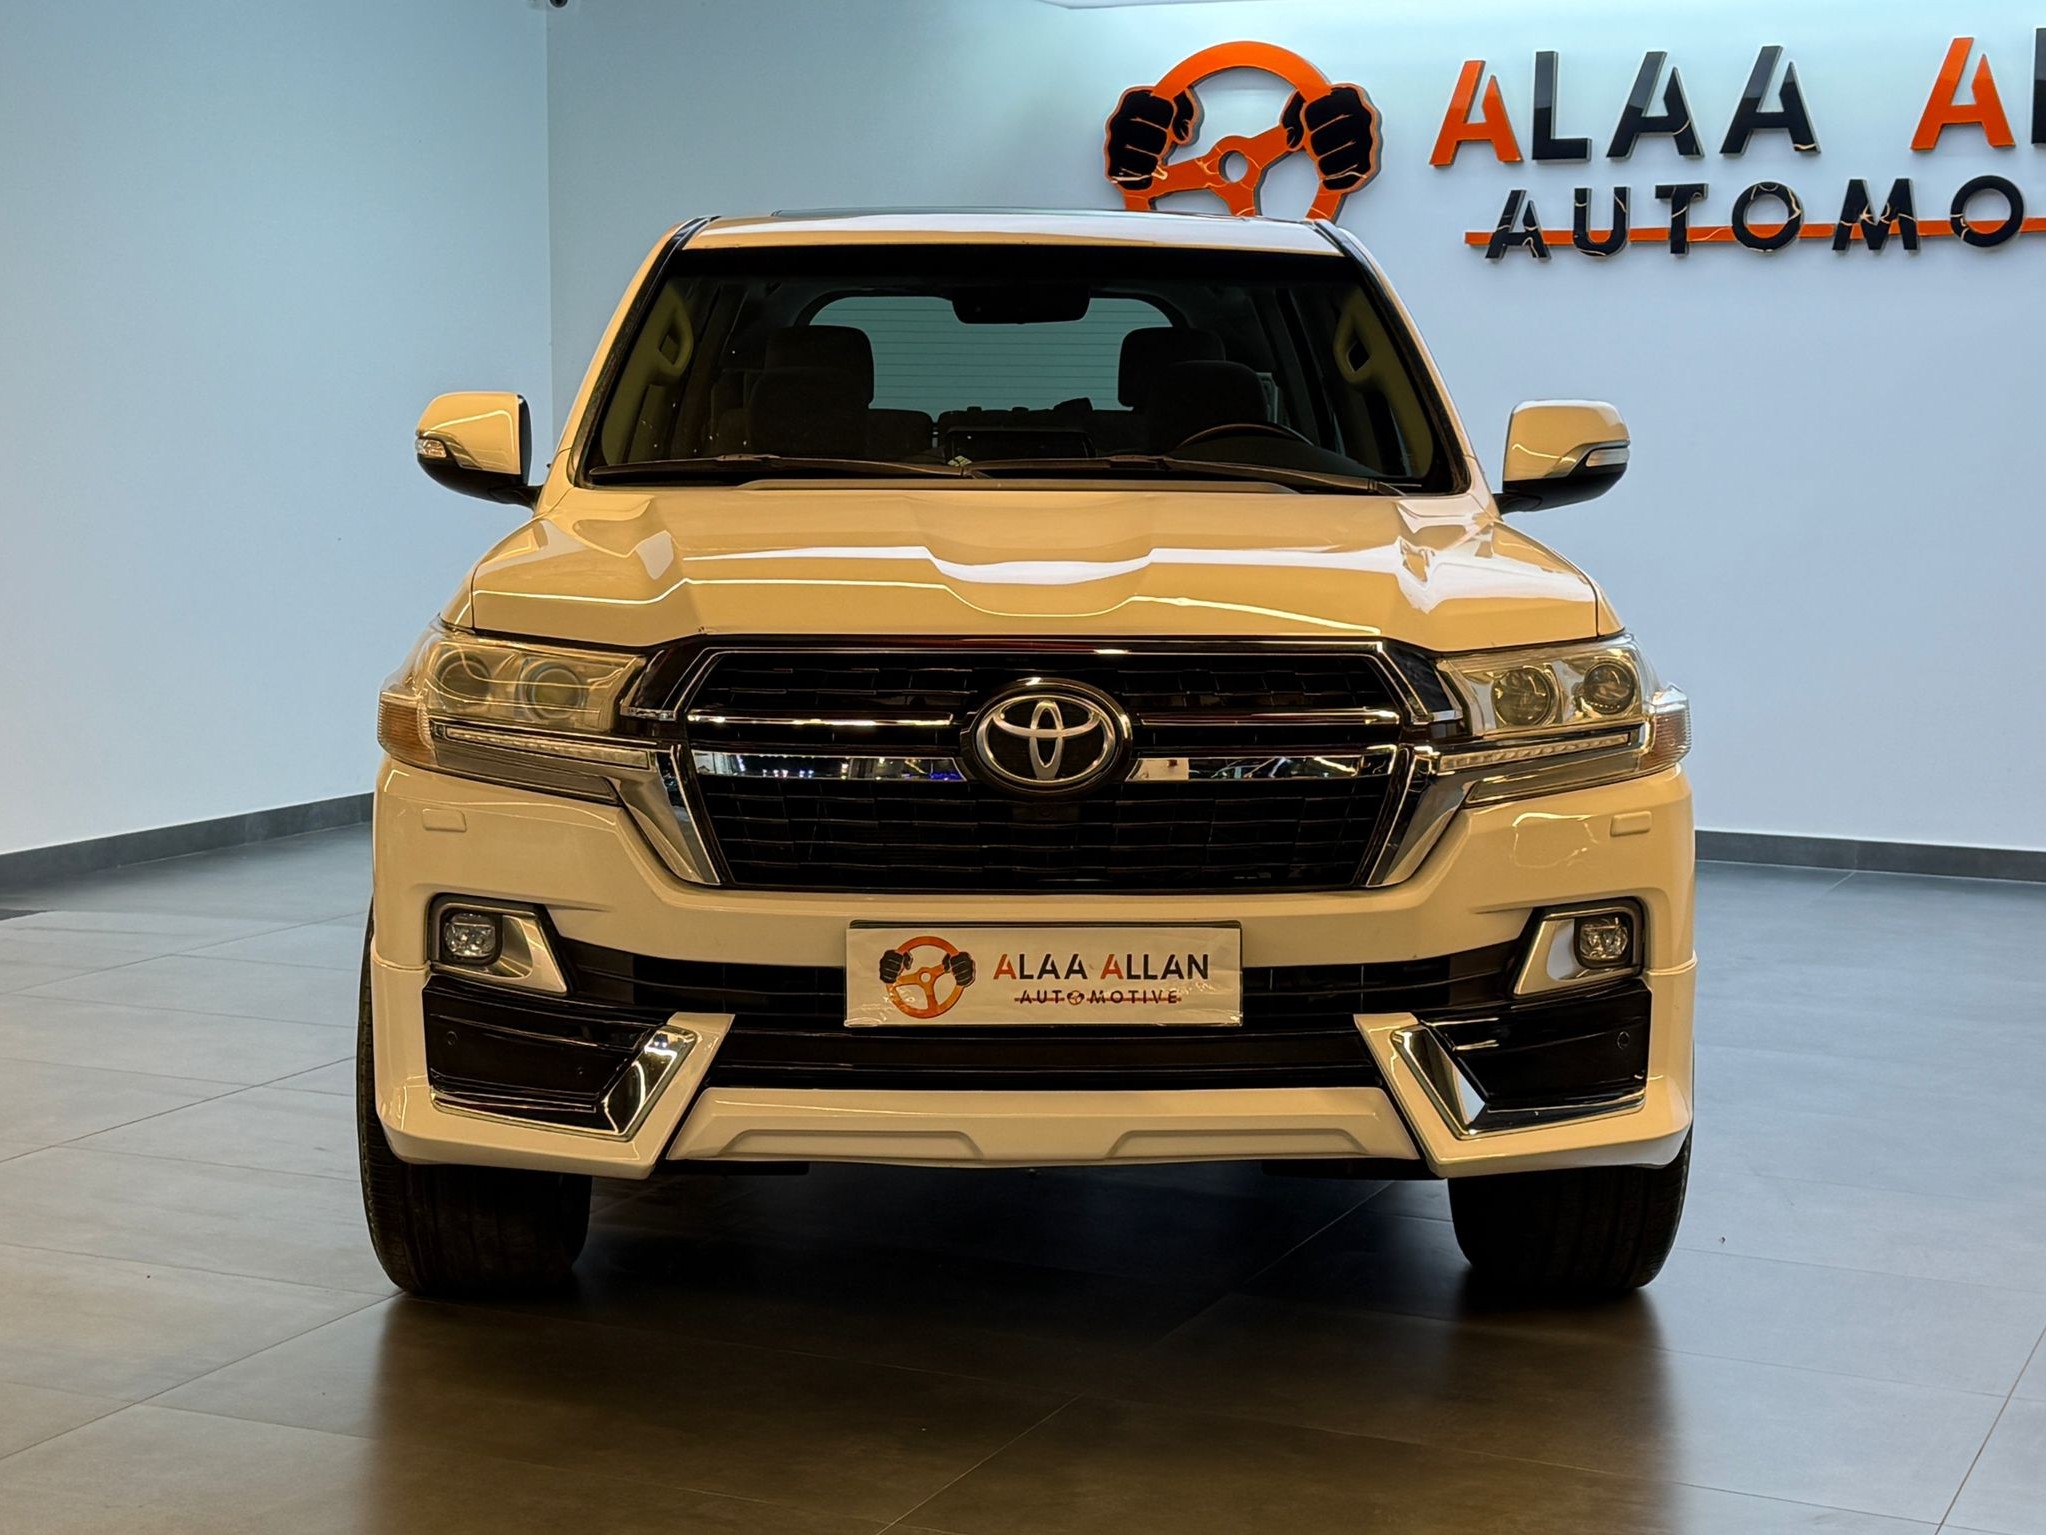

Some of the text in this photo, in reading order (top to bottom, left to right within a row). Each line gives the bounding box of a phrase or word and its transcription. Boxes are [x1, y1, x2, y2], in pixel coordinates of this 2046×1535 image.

[1429, 27, 2046, 166] ALAA A
[1484, 174, 2025, 260] AUTOMO
[993, 953, 1209, 980] ALAA ALLAN
